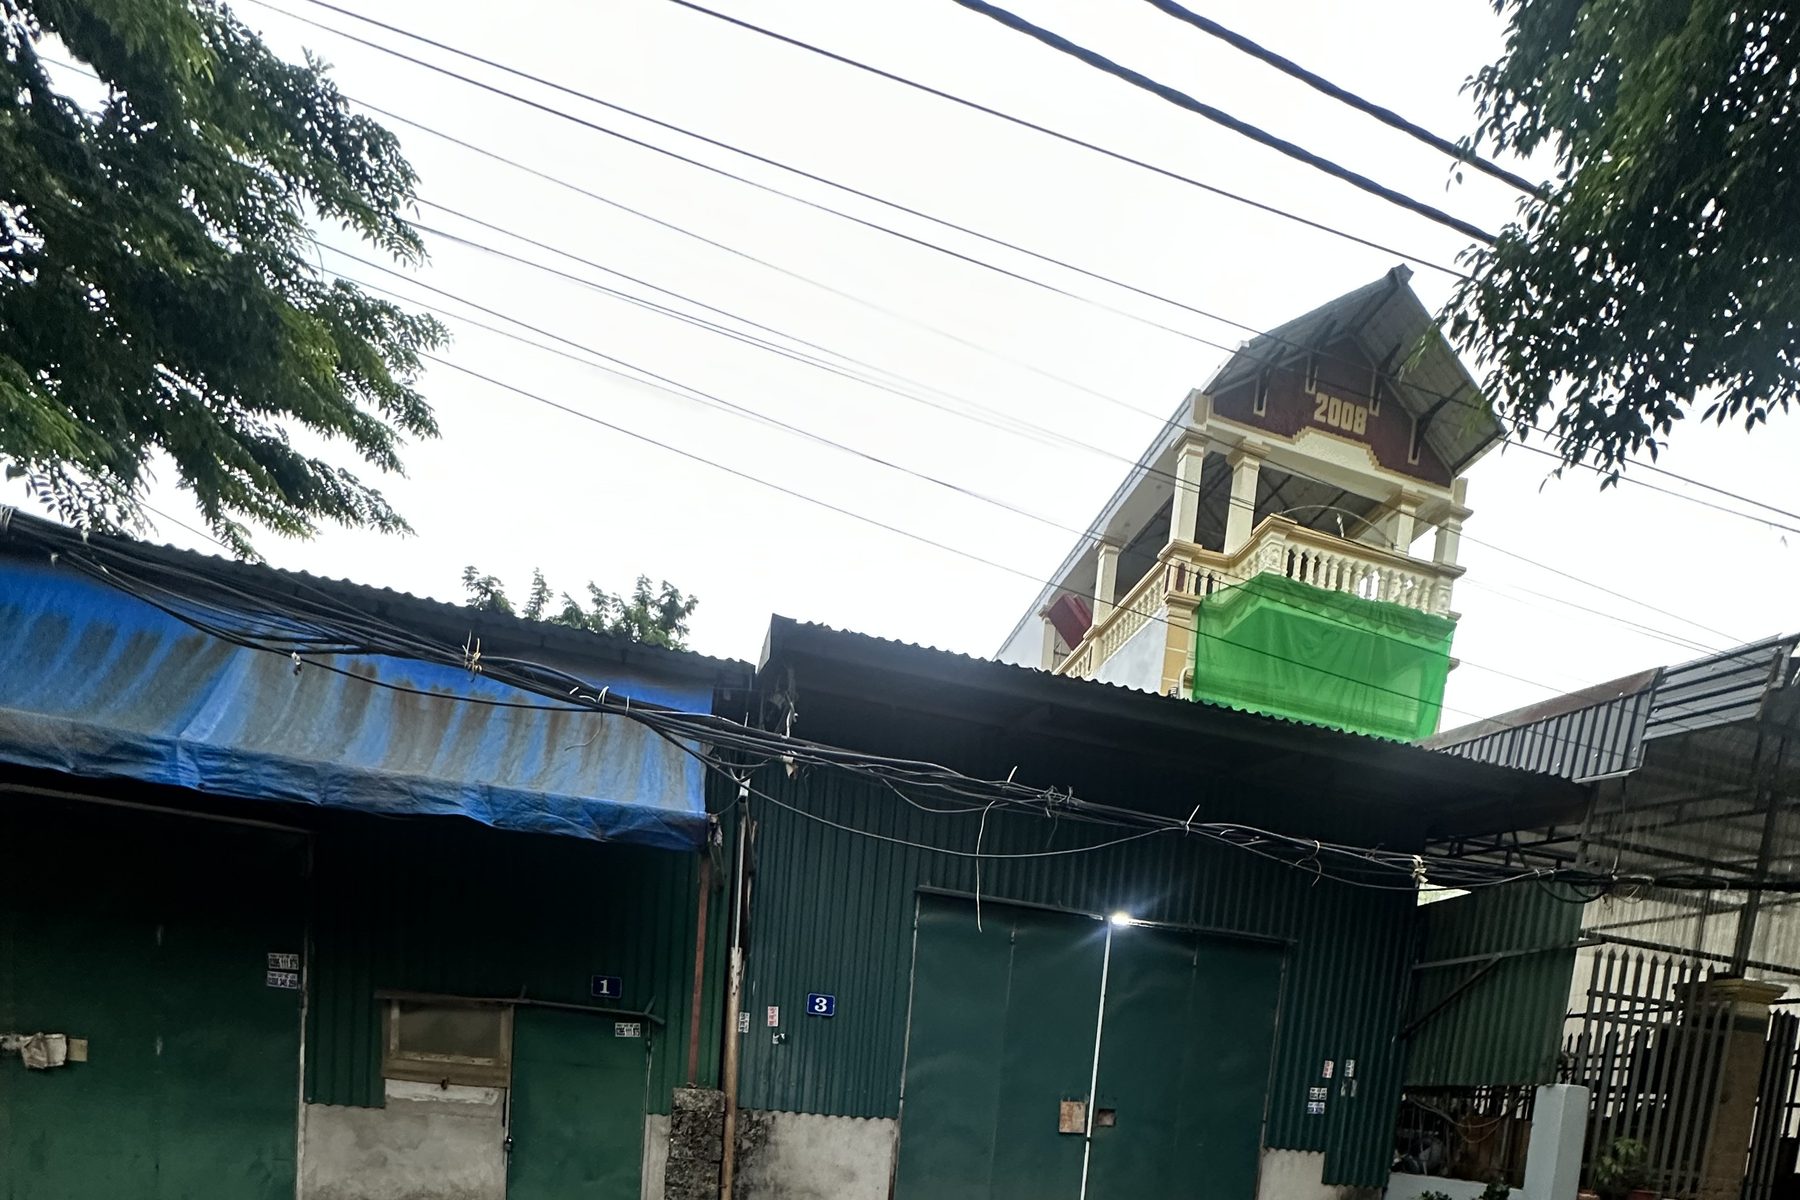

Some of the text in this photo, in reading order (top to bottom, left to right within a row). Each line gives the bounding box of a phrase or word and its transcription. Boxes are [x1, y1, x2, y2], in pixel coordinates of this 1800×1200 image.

[1313, 392, 1368, 436] 2008
[599, 979, 610, 994] 1
[814, 997, 828, 1013] 3
